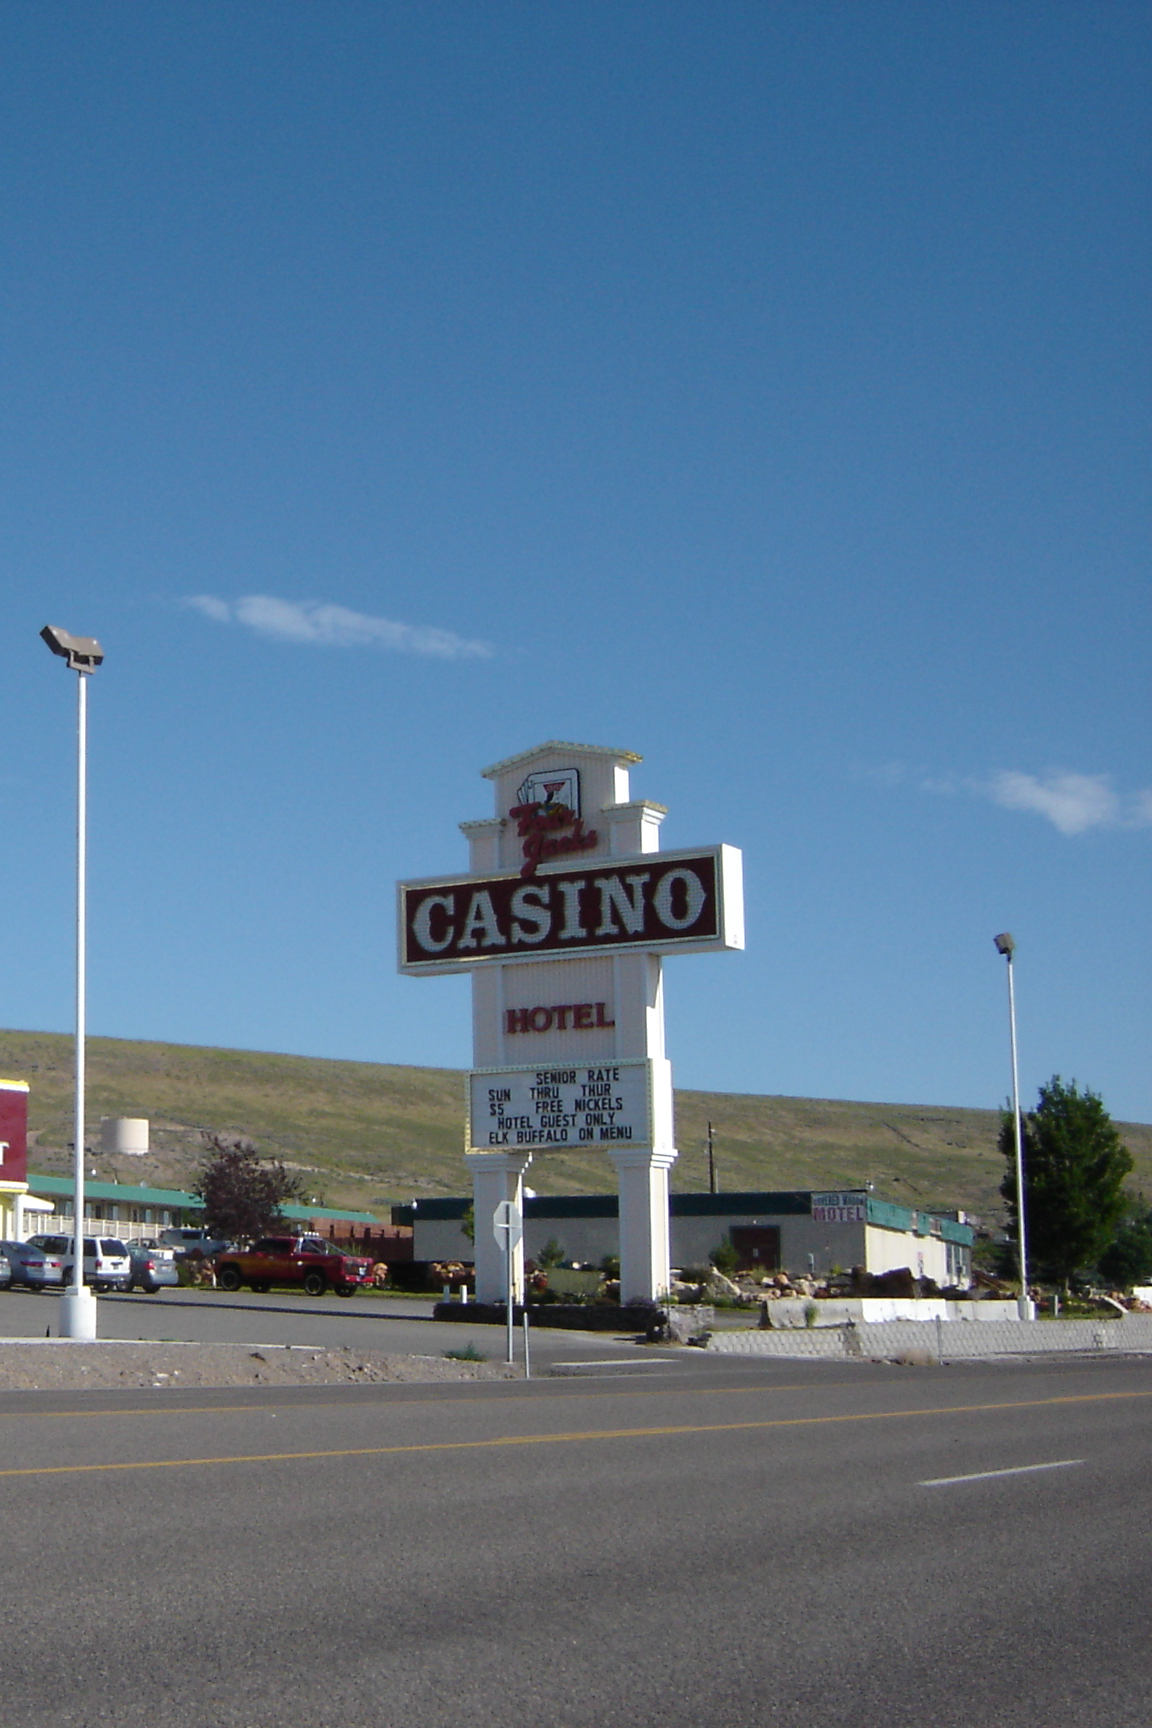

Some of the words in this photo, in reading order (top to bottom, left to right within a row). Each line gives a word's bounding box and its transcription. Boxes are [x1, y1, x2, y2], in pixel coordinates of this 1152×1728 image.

[411, 868, 707, 953] CASINO
[506, 1003, 615, 1034] HOTEL
[536, 1071, 576, 1085] SENIOR
[588, 1068, 619, 1082] RATE
[488, 1089, 510, 1101] SUN
[530, 1087, 559, 1099] THRU
[581, 1084, 611, 1097] THUR
[535, 1100, 563, 1114] FREE
[575, 1097, 623, 1112] NICKELS
[498, 1115, 533, 1130] HOTEL
[540, 1114, 577, 1128] GUEST
[585, 1112, 615, 1126] ONLY
[489, 1132, 509, 1144] ELK
[517, 1129, 568, 1143] BUFFALO
[579, 1127, 593, 1140] ON
[600, 1126, 632, 1140] MENU
[813, 1206, 864, 1221] MOTEL
